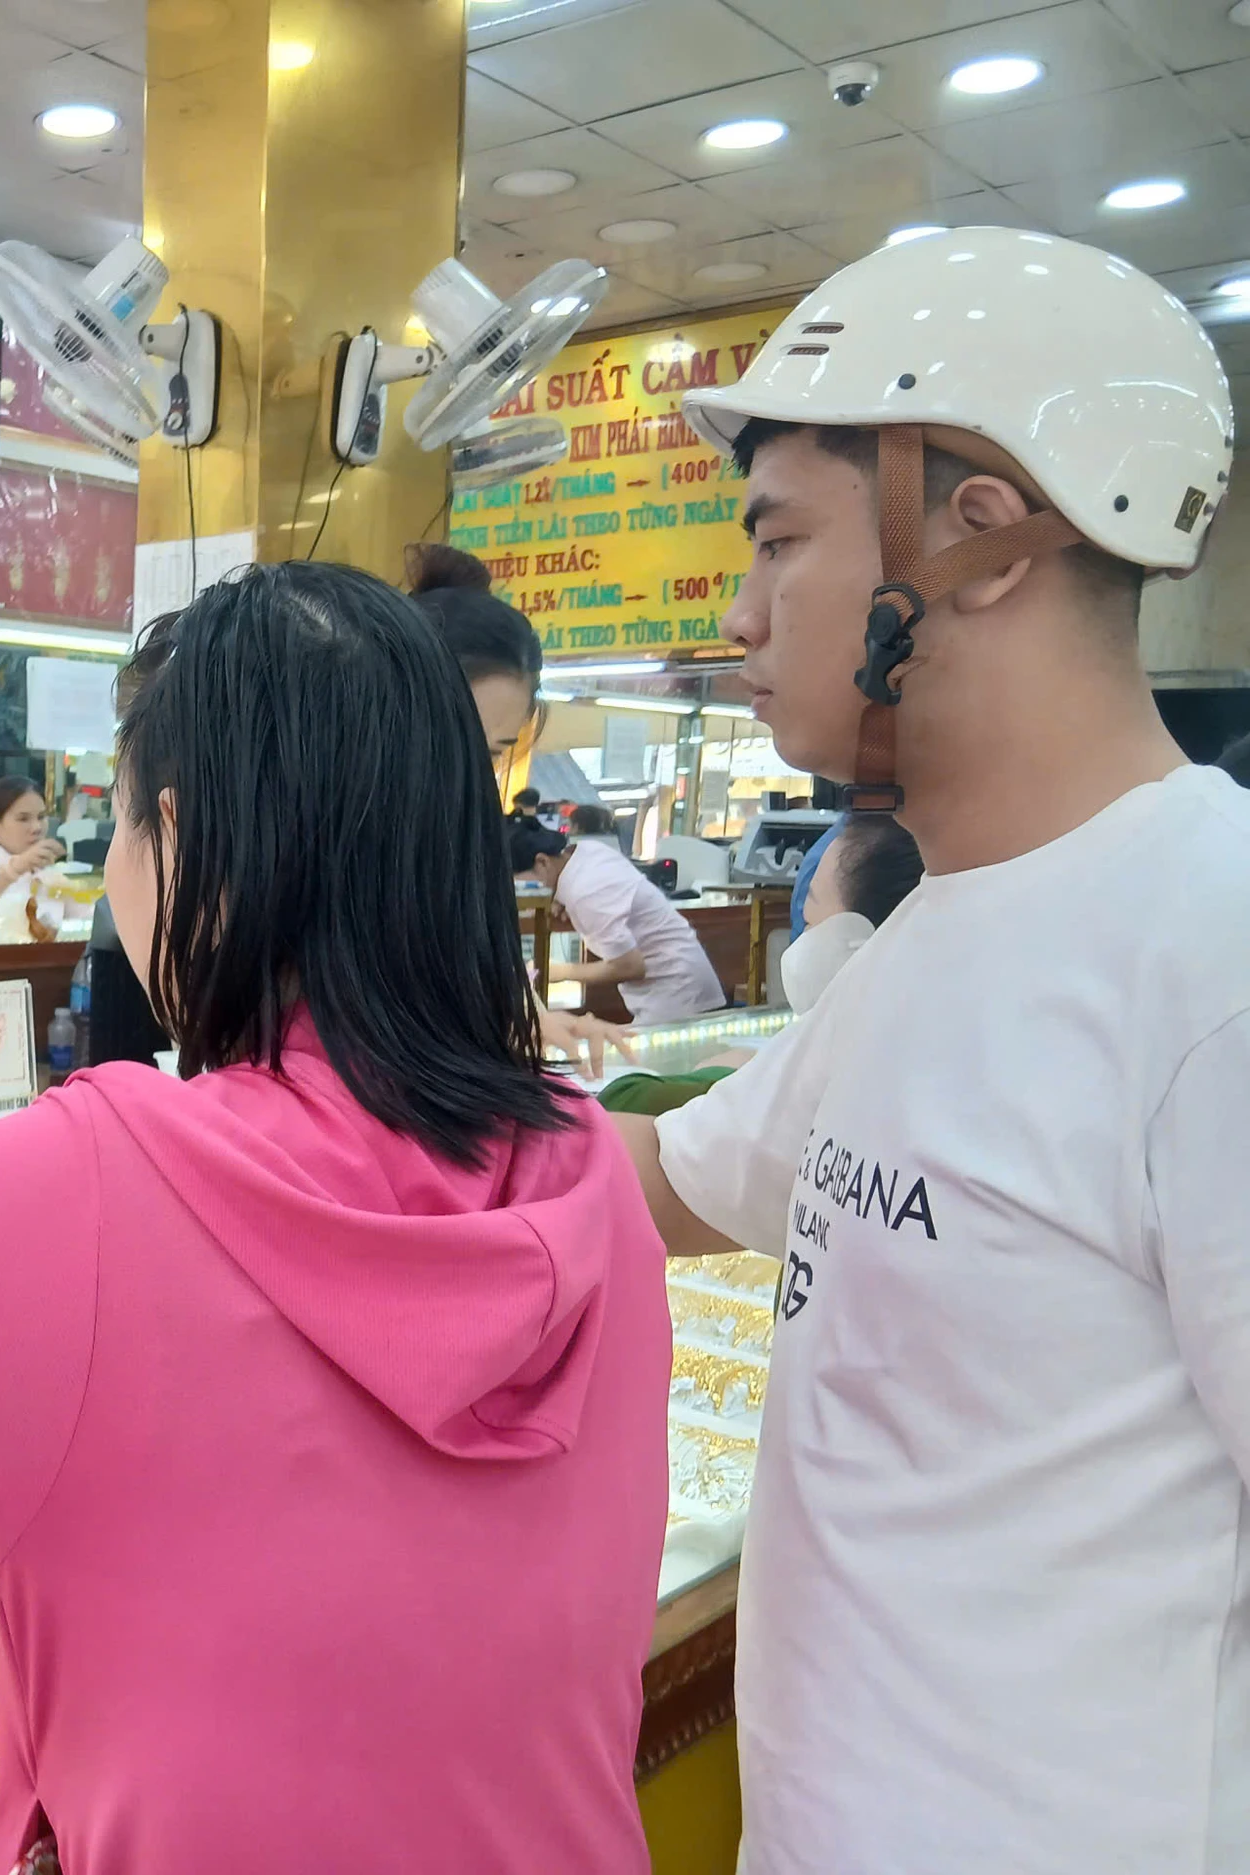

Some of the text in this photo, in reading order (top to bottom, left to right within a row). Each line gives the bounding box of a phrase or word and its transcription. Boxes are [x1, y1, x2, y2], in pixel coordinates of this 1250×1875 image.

[546, 349, 631, 412] SUẤT
[572, 510, 621, 537] THEO
[683, 492, 740, 524] NGÀY
[535, 541, 601, 576] KHÁC:
[568, 624, 616, 650] THEO
[679, 609, 724, 642] NGÀ
